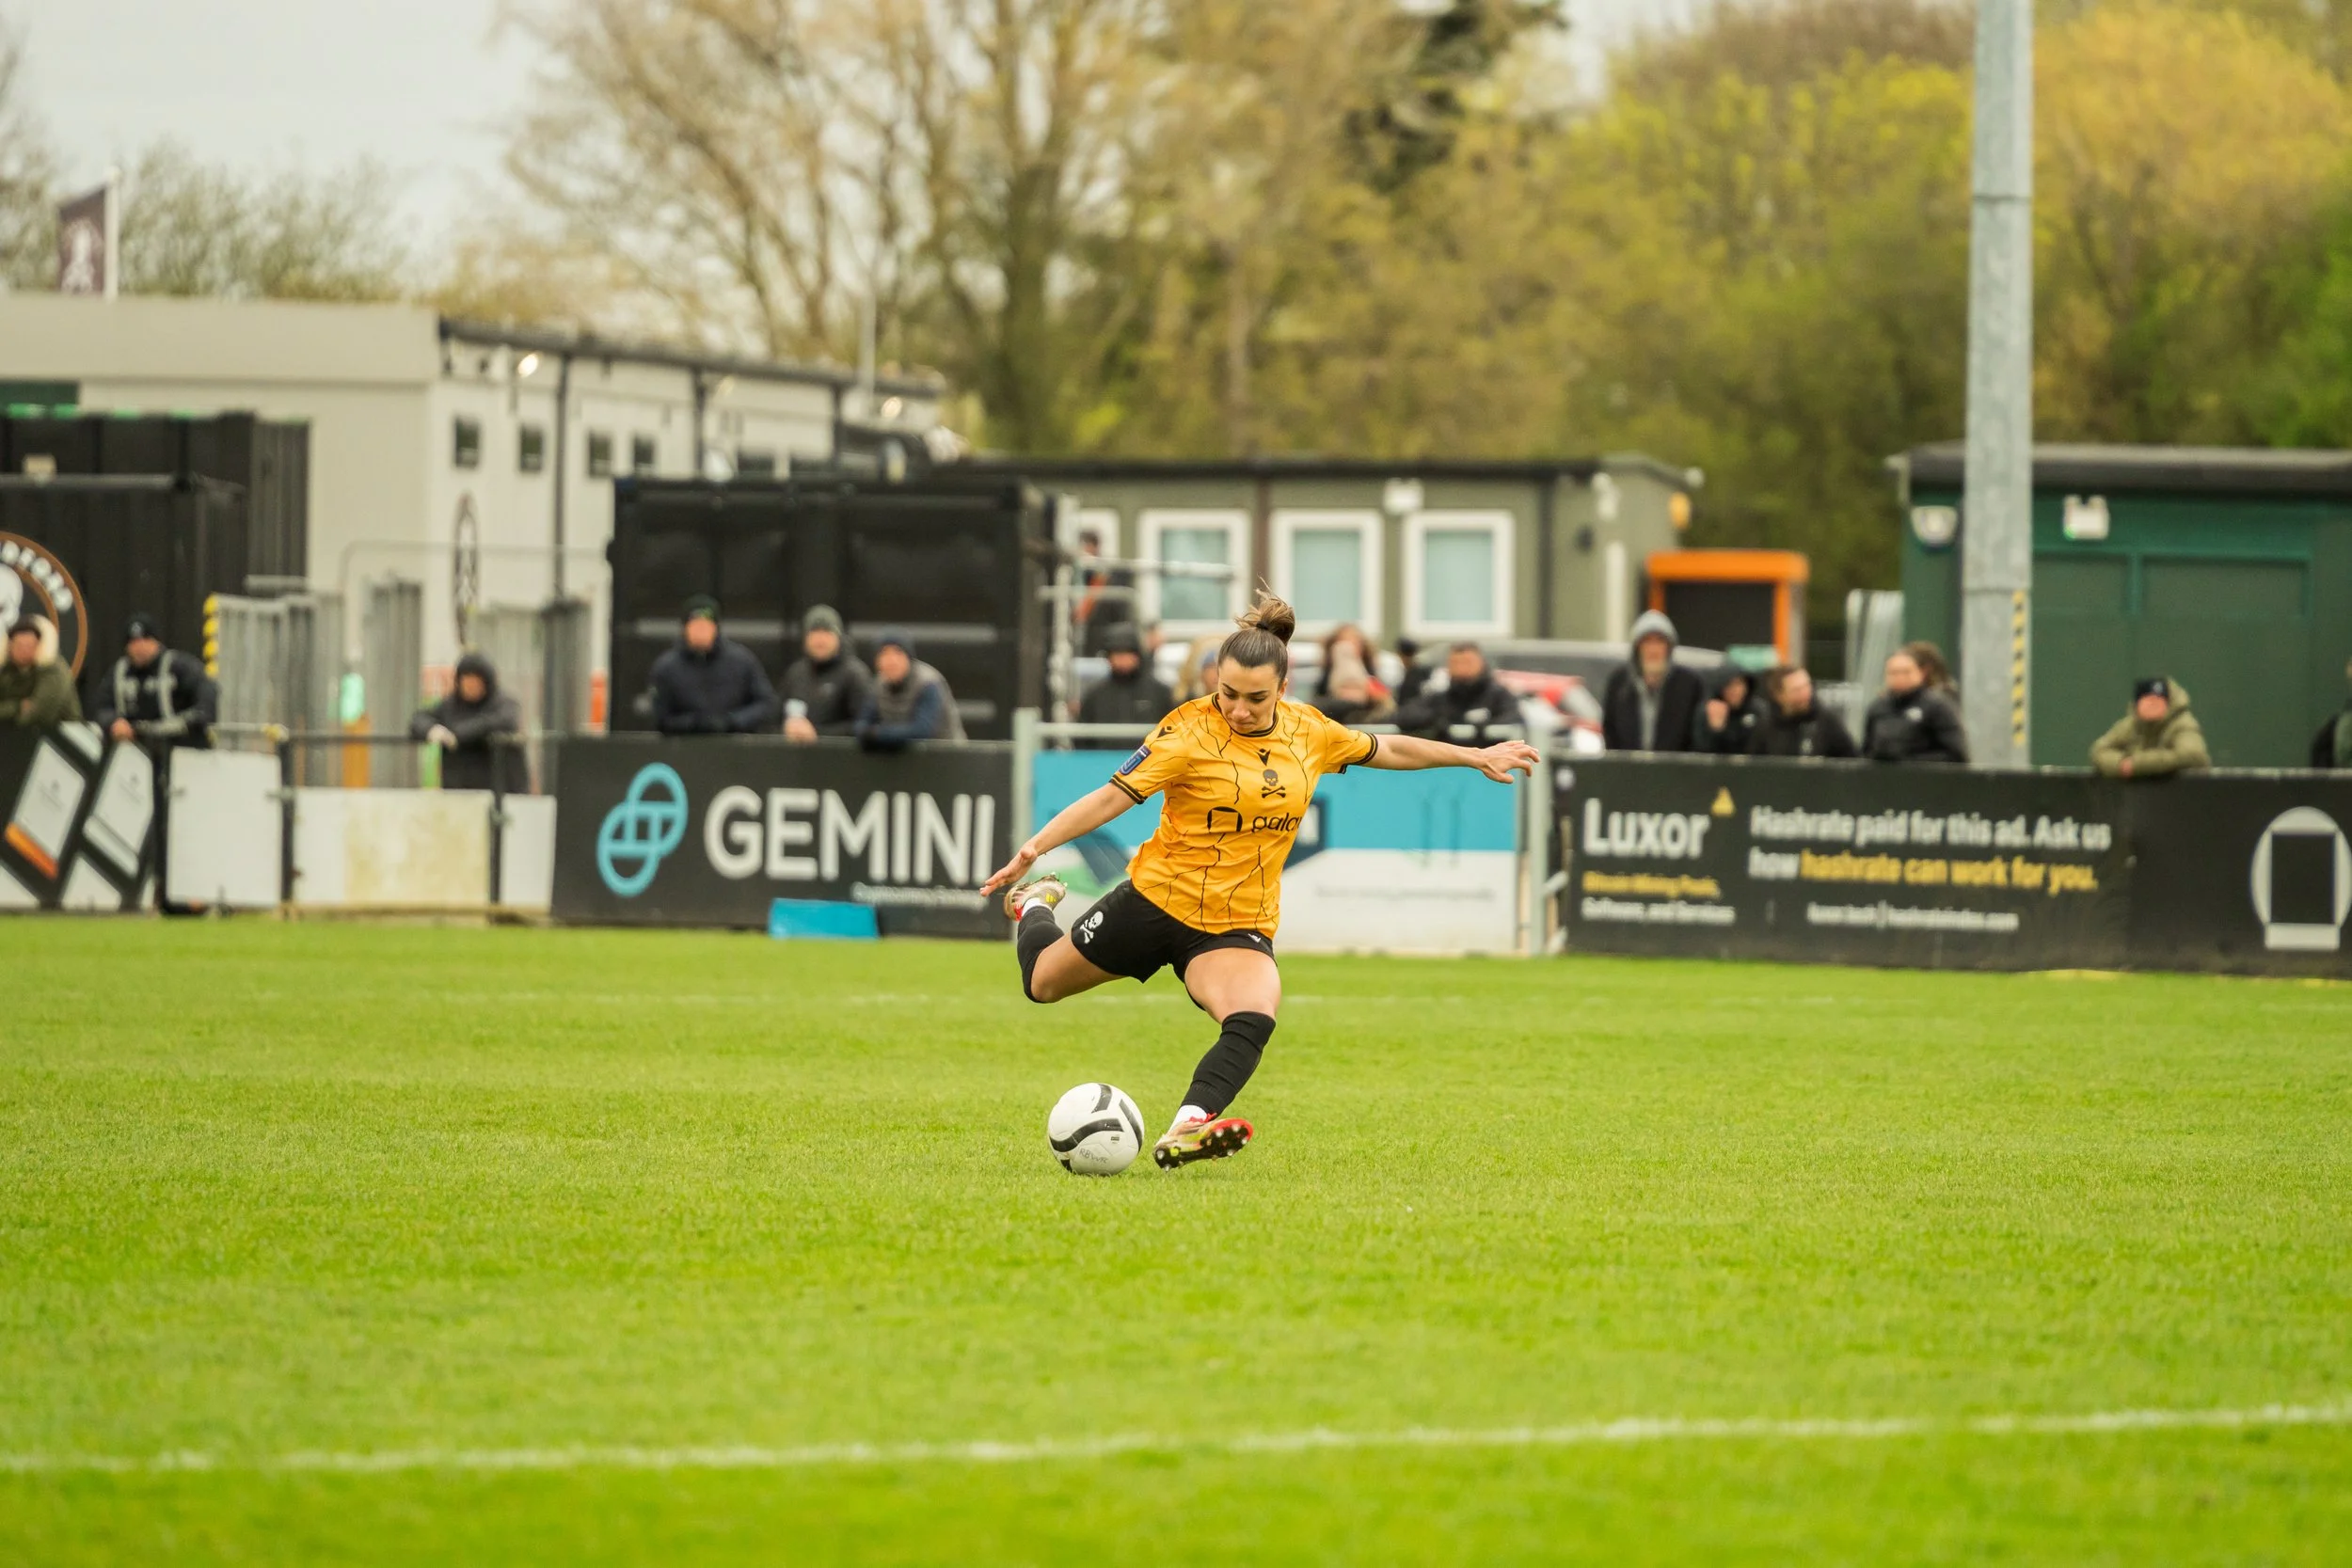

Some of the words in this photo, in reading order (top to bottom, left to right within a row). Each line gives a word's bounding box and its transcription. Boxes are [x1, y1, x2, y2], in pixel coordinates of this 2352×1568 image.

[0, 539, 73, 612] DFORD
[704, 784, 995, 885] GEMINI
[1582, 798, 1710, 860] Luxor
[1751, 805, 1855, 840] Hashrate
[1855, 809, 1909, 847] paid
[1910, 810, 1945, 845] for
[1947, 812, 1993, 847] this
[1994, 815, 2031, 847] ad.
[2032, 815, 2079, 849] Ask
[2081, 823, 2112, 850] us
[1748, 847, 1800, 879] how
[1800, 848, 1901, 883] hashrate
[1903, 858, 1947, 885] can
[1950, 855, 2008, 888] work
[2010, 855, 2045, 889] for
[2048, 863, 2099, 897] you.
